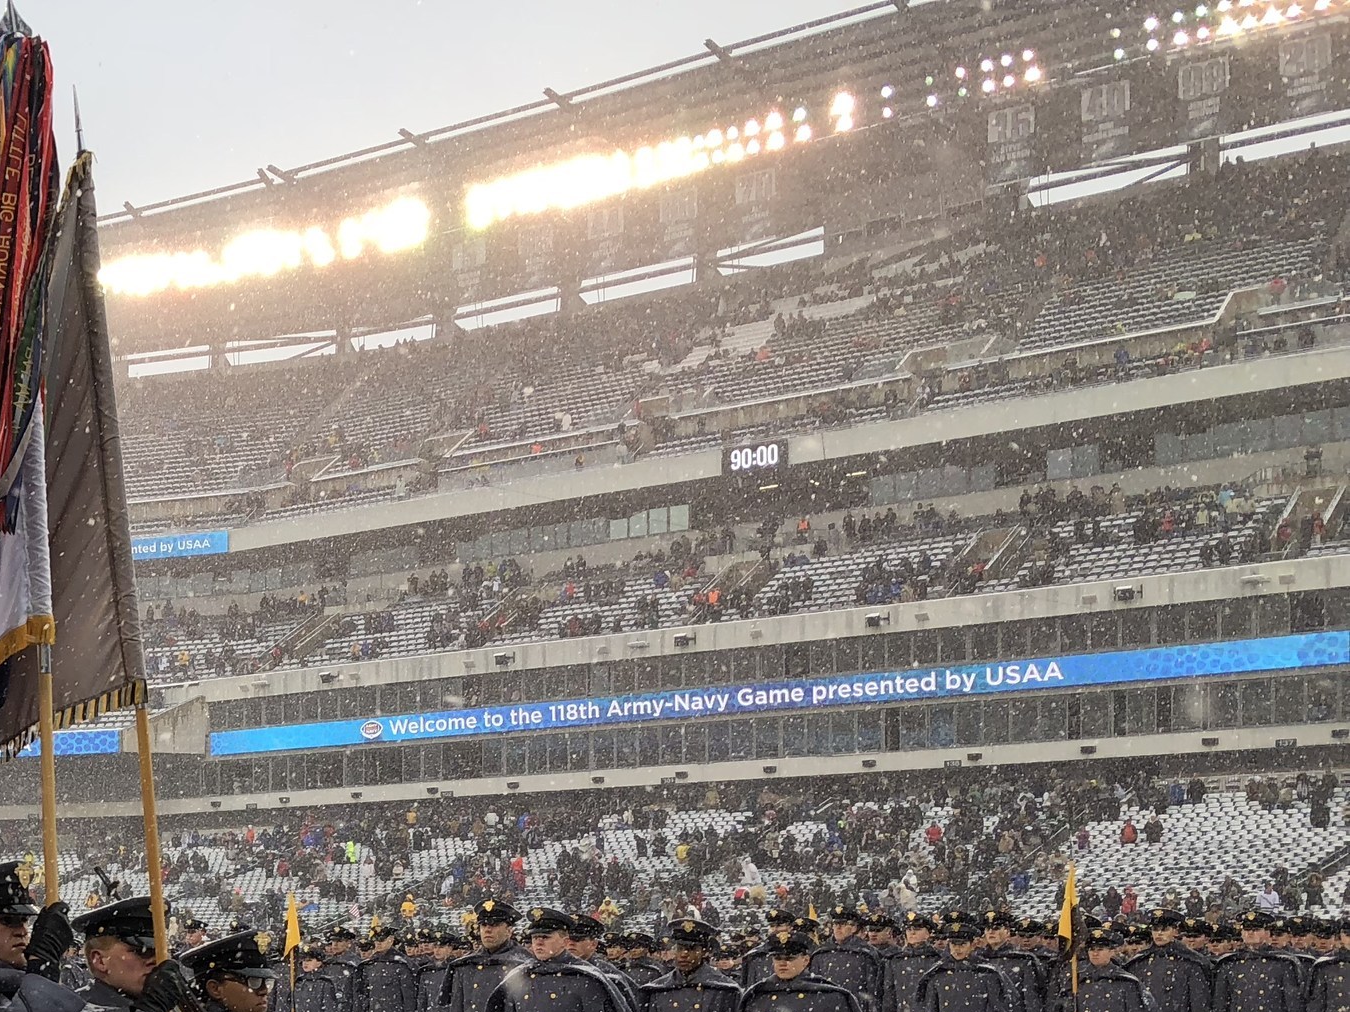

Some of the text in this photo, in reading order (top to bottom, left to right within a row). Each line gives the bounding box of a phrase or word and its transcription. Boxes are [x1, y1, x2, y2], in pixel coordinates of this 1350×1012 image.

[731, 444, 778, 470] 90:00
[160, 542, 174, 552] by
[177, 539, 211, 550] USAA
[389, 716, 477, 735] Welcome
[484, 707, 504, 726] to
[510, 706, 542, 725] the
[549, 701, 600, 722] 118th
[607, 690, 729, 718] Army-Navy
[737, 688, 804, 706] Game
[813, 672, 936, 703] presented
[946, 669, 975, 692] by
[986, 661, 1064, 686] USAA
